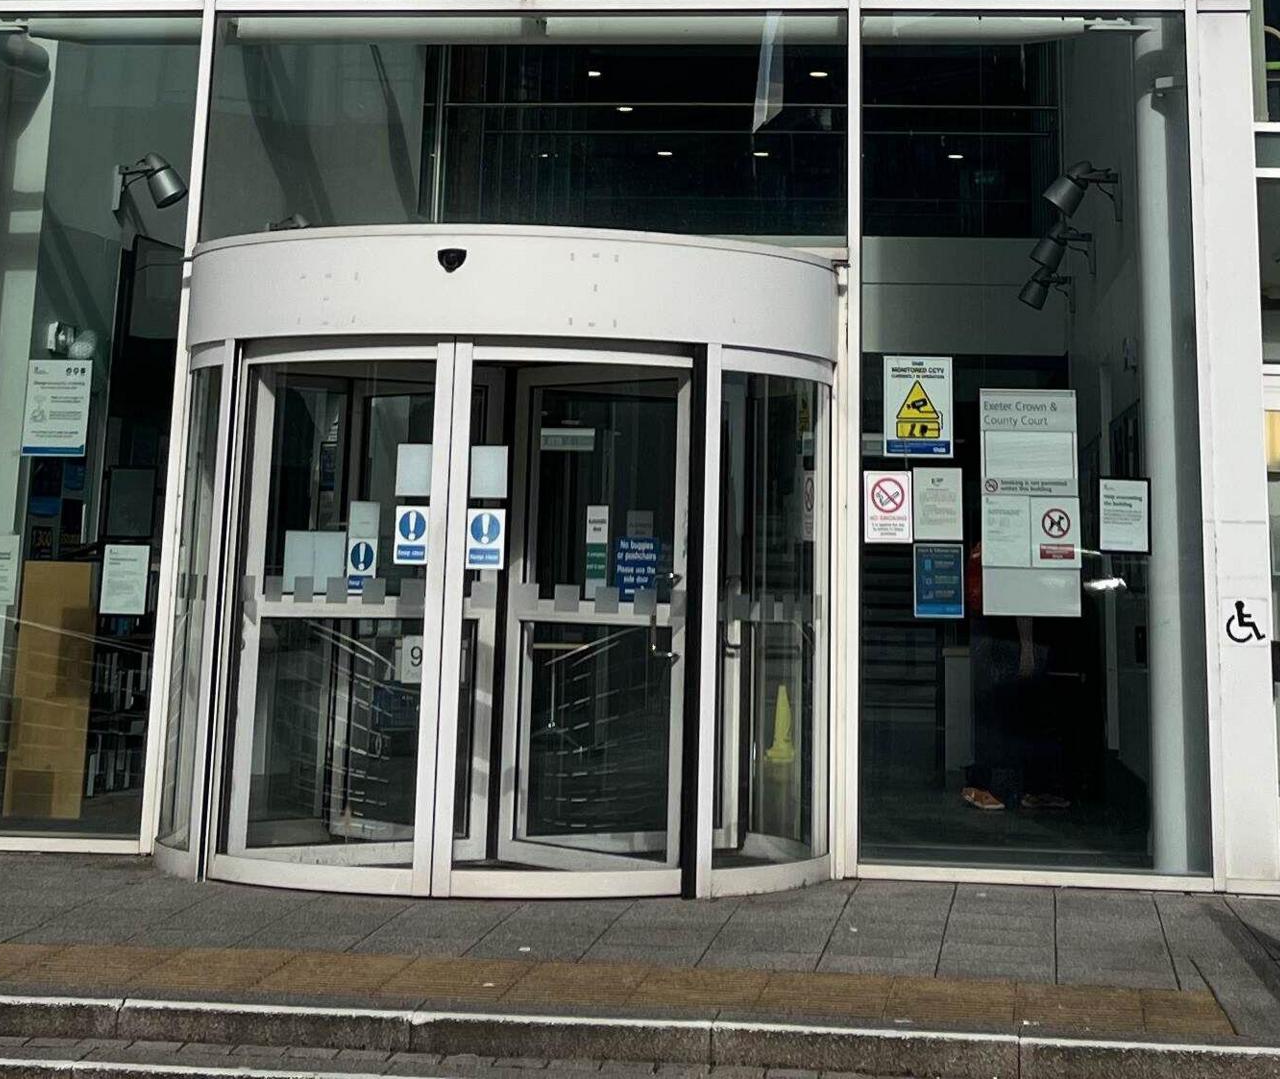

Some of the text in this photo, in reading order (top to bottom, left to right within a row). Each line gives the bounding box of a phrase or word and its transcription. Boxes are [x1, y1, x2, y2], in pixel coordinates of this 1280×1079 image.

[983, 401, 1058, 412] Exeter Crown &
[983, 415, 1048, 426] County Court
[620, 539, 629, 549] No
[616, 564, 634, 573] Please
